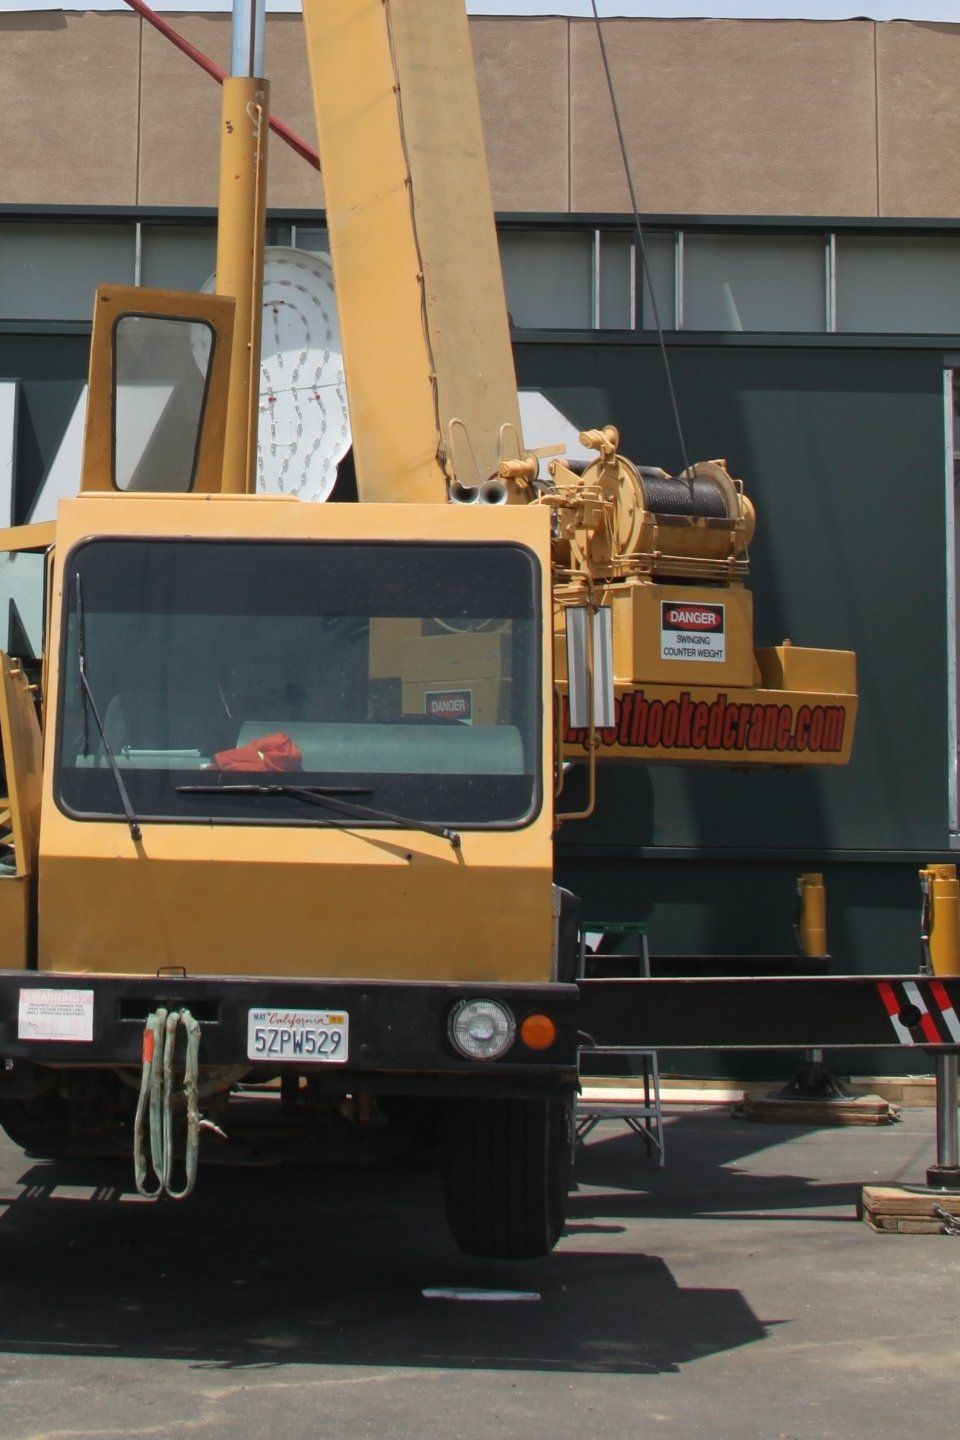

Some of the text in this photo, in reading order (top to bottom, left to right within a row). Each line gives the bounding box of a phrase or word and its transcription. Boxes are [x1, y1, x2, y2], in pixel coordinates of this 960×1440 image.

[670, 611, 716, 625] DANGER
[676, 634, 711, 646] SWINGING
[663, 646, 724, 659] COUNTER WEIGHT
[431, 699, 466, 712] DANGER
[253, 1013, 267, 1021] MAY
[269, 1012, 326, 1027] California
[254, 1028, 342, 1055] 5ZPW529
